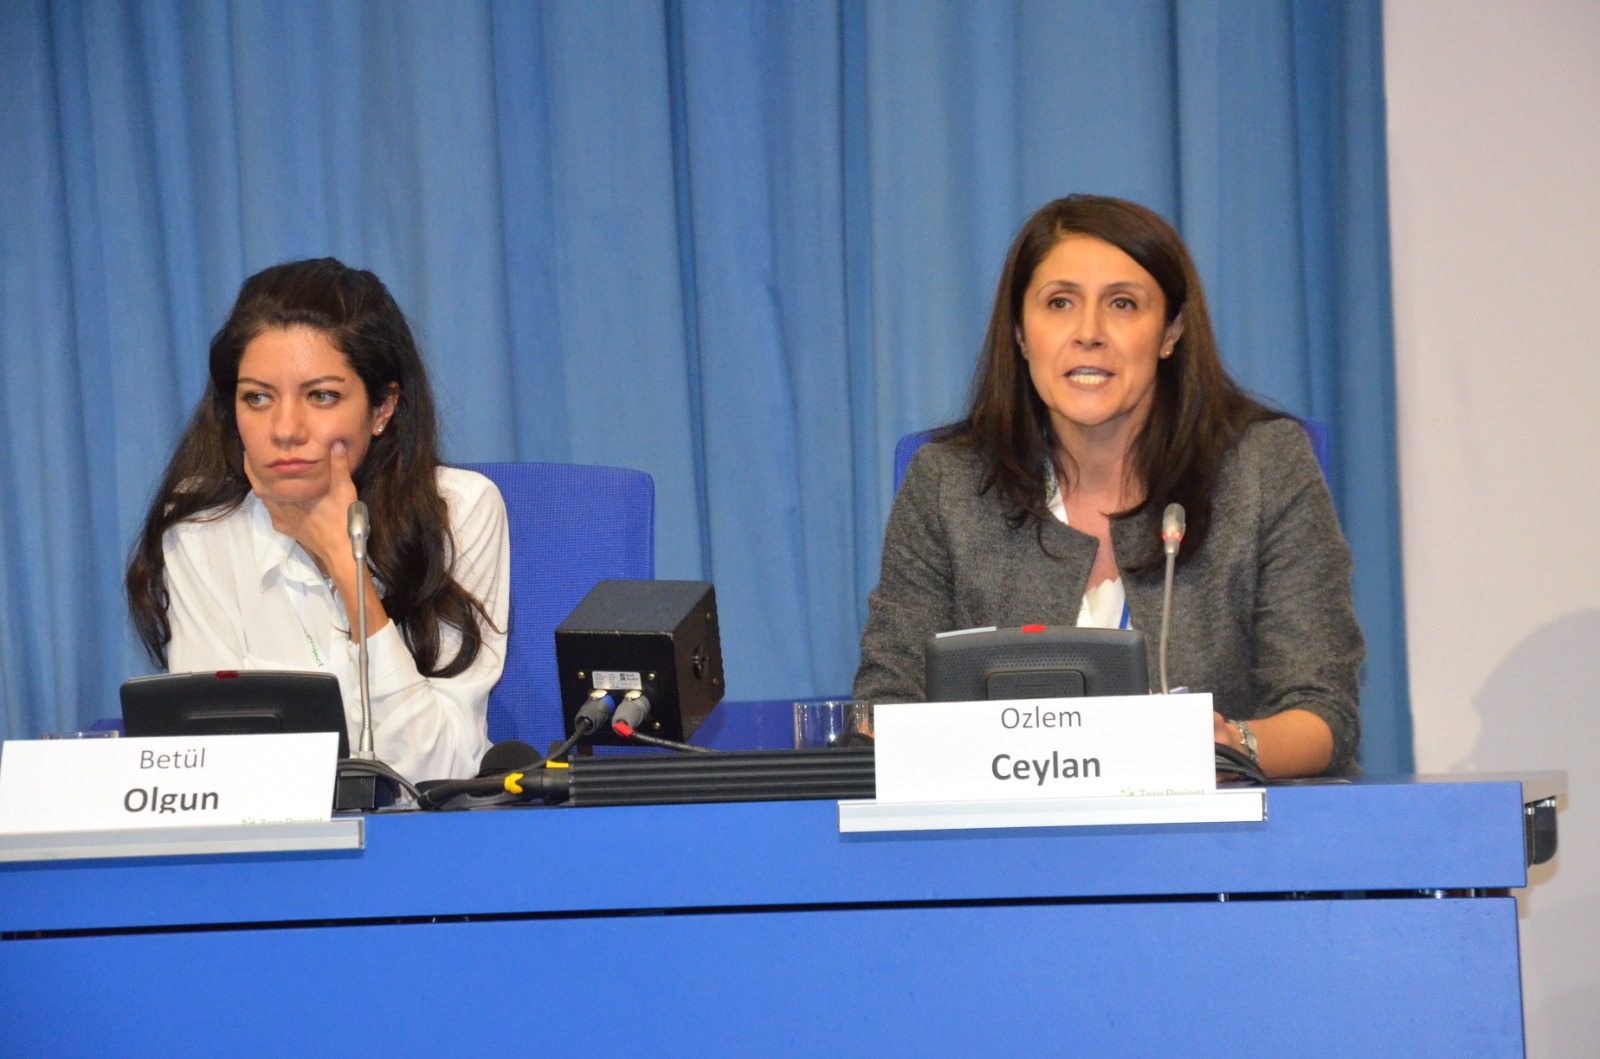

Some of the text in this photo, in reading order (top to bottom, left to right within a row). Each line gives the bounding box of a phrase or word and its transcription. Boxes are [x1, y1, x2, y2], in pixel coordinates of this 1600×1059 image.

[1001, 706, 1082, 730] Ozlem
[140, 747, 206, 770] Betül
[991, 751, 1101, 786] Ceylan
[124, 786, 220, 814] Olgun
